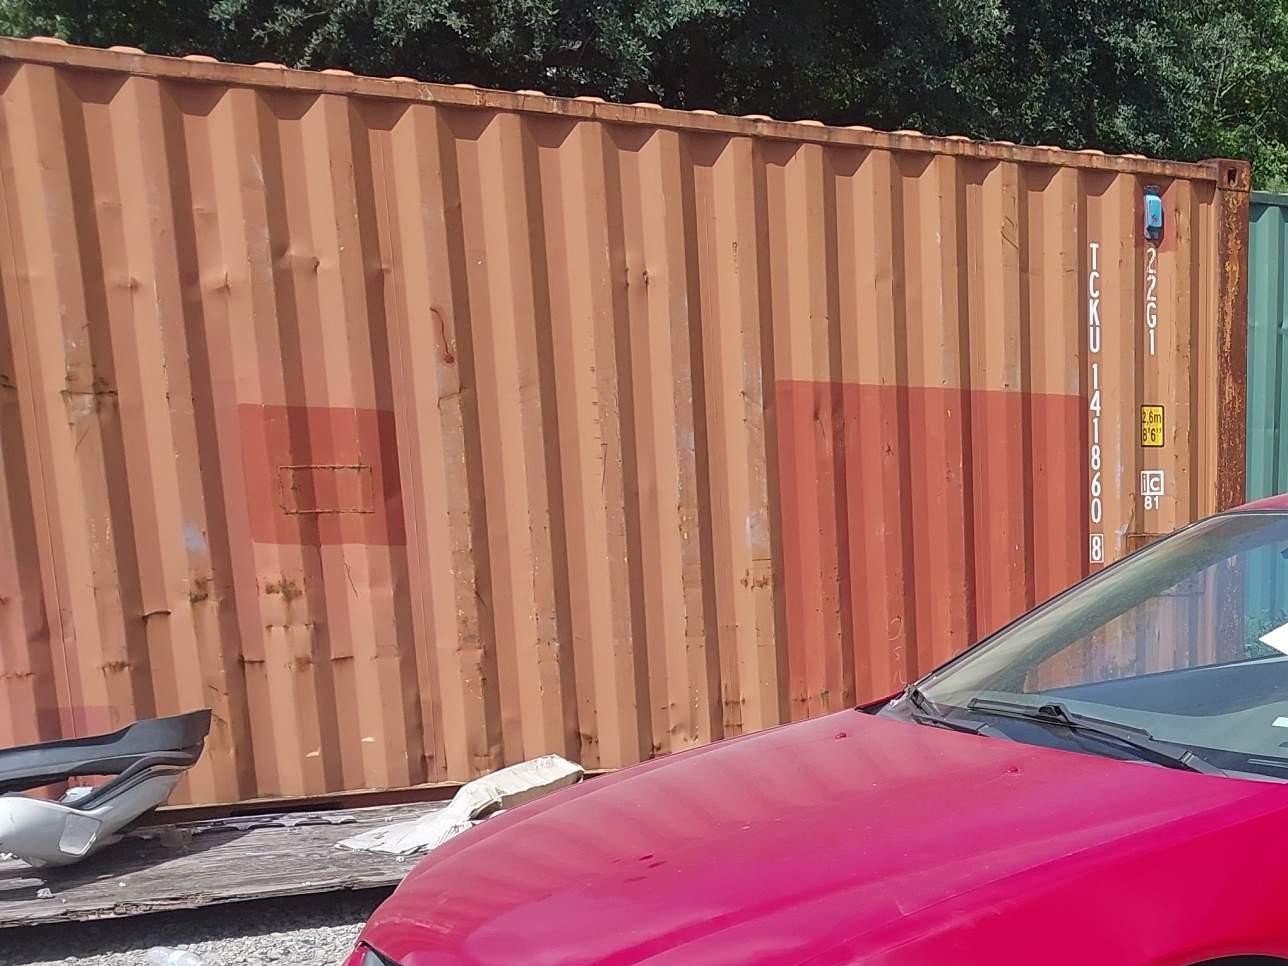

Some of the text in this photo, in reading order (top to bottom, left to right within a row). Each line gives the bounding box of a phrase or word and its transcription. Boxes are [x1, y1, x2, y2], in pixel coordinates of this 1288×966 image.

[1146, 246, 1158, 356] 22G1
[1089, 242, 1102, 561] TCKU 141860 8
[1142, 410, 1162, 425] 2,6m
[1143, 495, 1160, 510] 81
